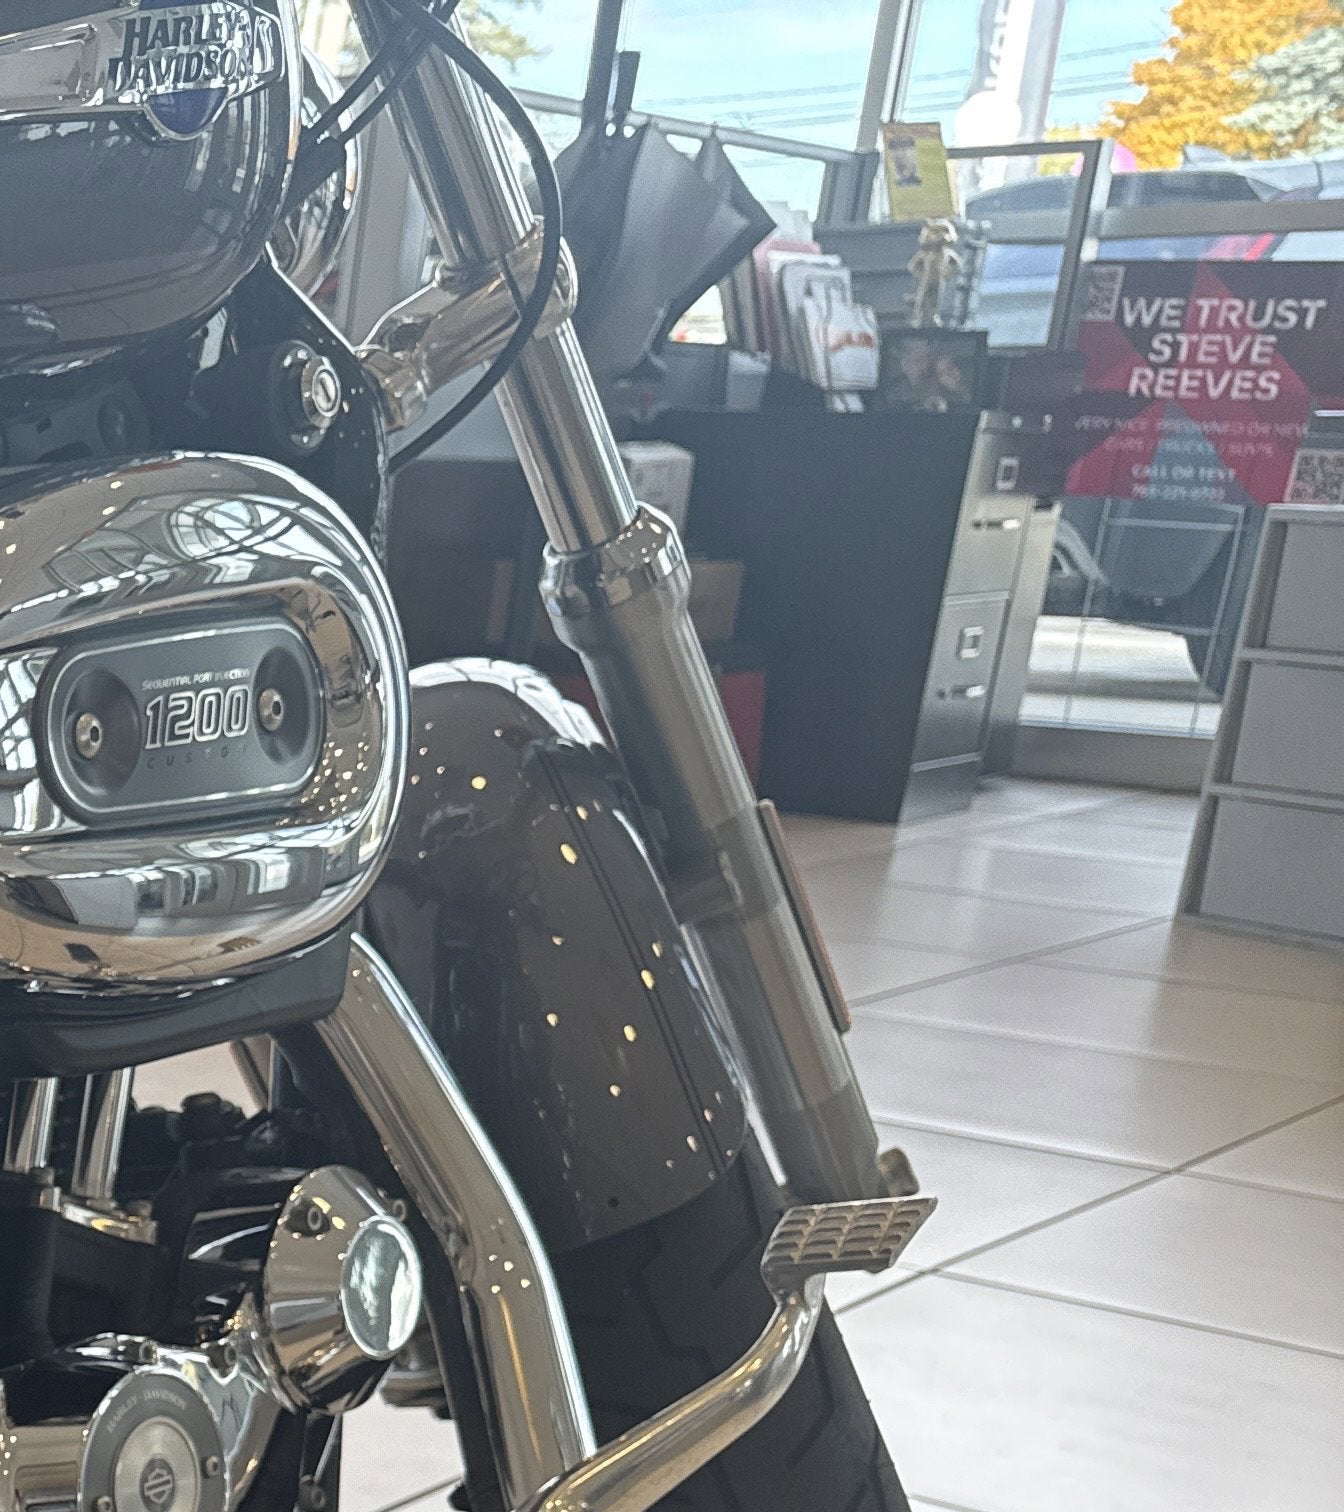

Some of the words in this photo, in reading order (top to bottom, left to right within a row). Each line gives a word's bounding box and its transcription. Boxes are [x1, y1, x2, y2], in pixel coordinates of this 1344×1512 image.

[108, 49, 249, 92] DAVIDSON
[1122, 296, 1186, 328] WE
[1195, 298, 1328, 330] TRUST
[1148, 332, 1278, 365] STEVE
[1127, 366, 1282, 401] REEVES
[145, 684, 250, 750] 1200
